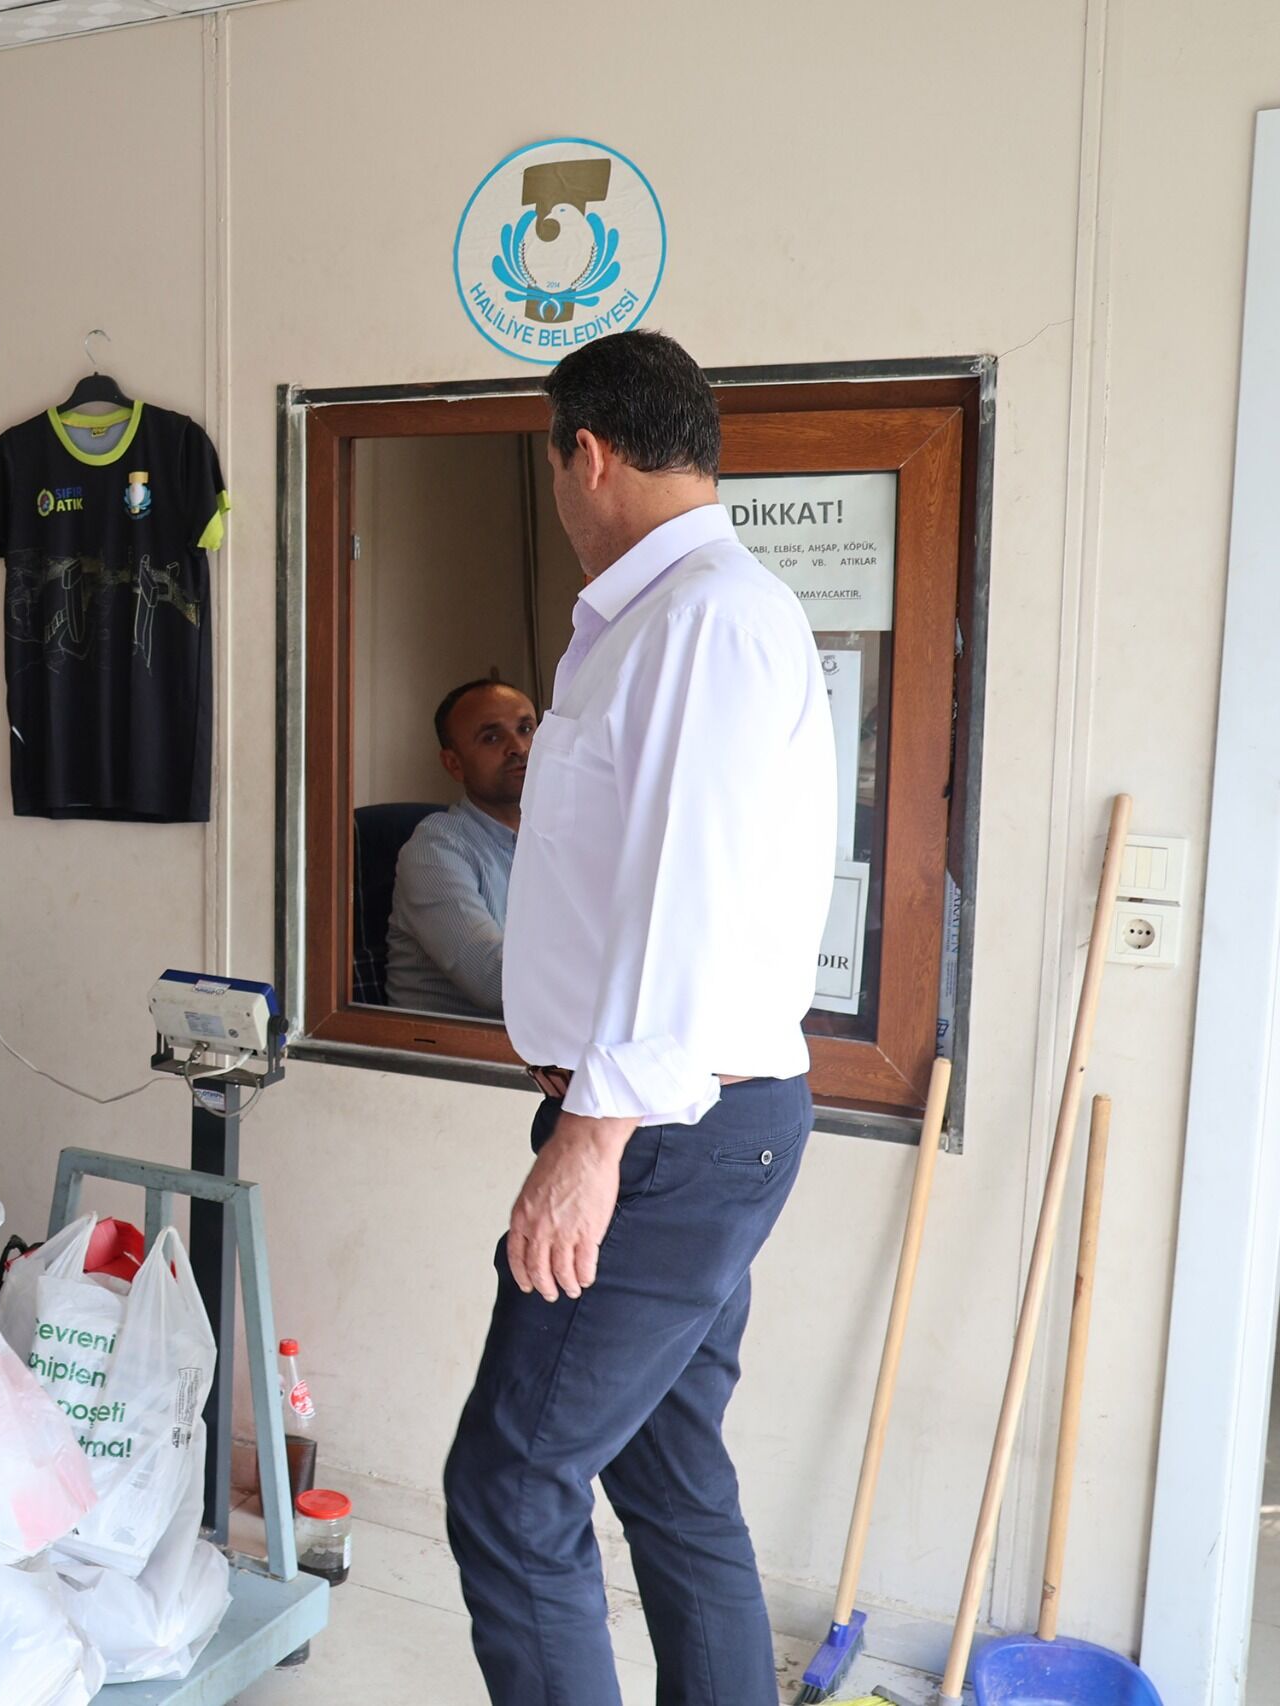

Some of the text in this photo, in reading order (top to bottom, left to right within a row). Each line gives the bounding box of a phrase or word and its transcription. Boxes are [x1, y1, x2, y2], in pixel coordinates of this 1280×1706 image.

[470, 282, 640, 347] HALİLİYE BELEDİYESİ
[56, 498, 83, 512] ATIK
[731, 498, 843, 527] DİKKAT!
[748, 541, 877, 554] KABI, ELBİSE, AHŞAP, KÖPÜK,
[779, 556, 877, 568] ÇÖP VB. ATIKLAR
[817, 953, 850, 971] DIR
[34, 1317, 117, 1354] evreni
[78, 1435, 133, 1459] tma!
